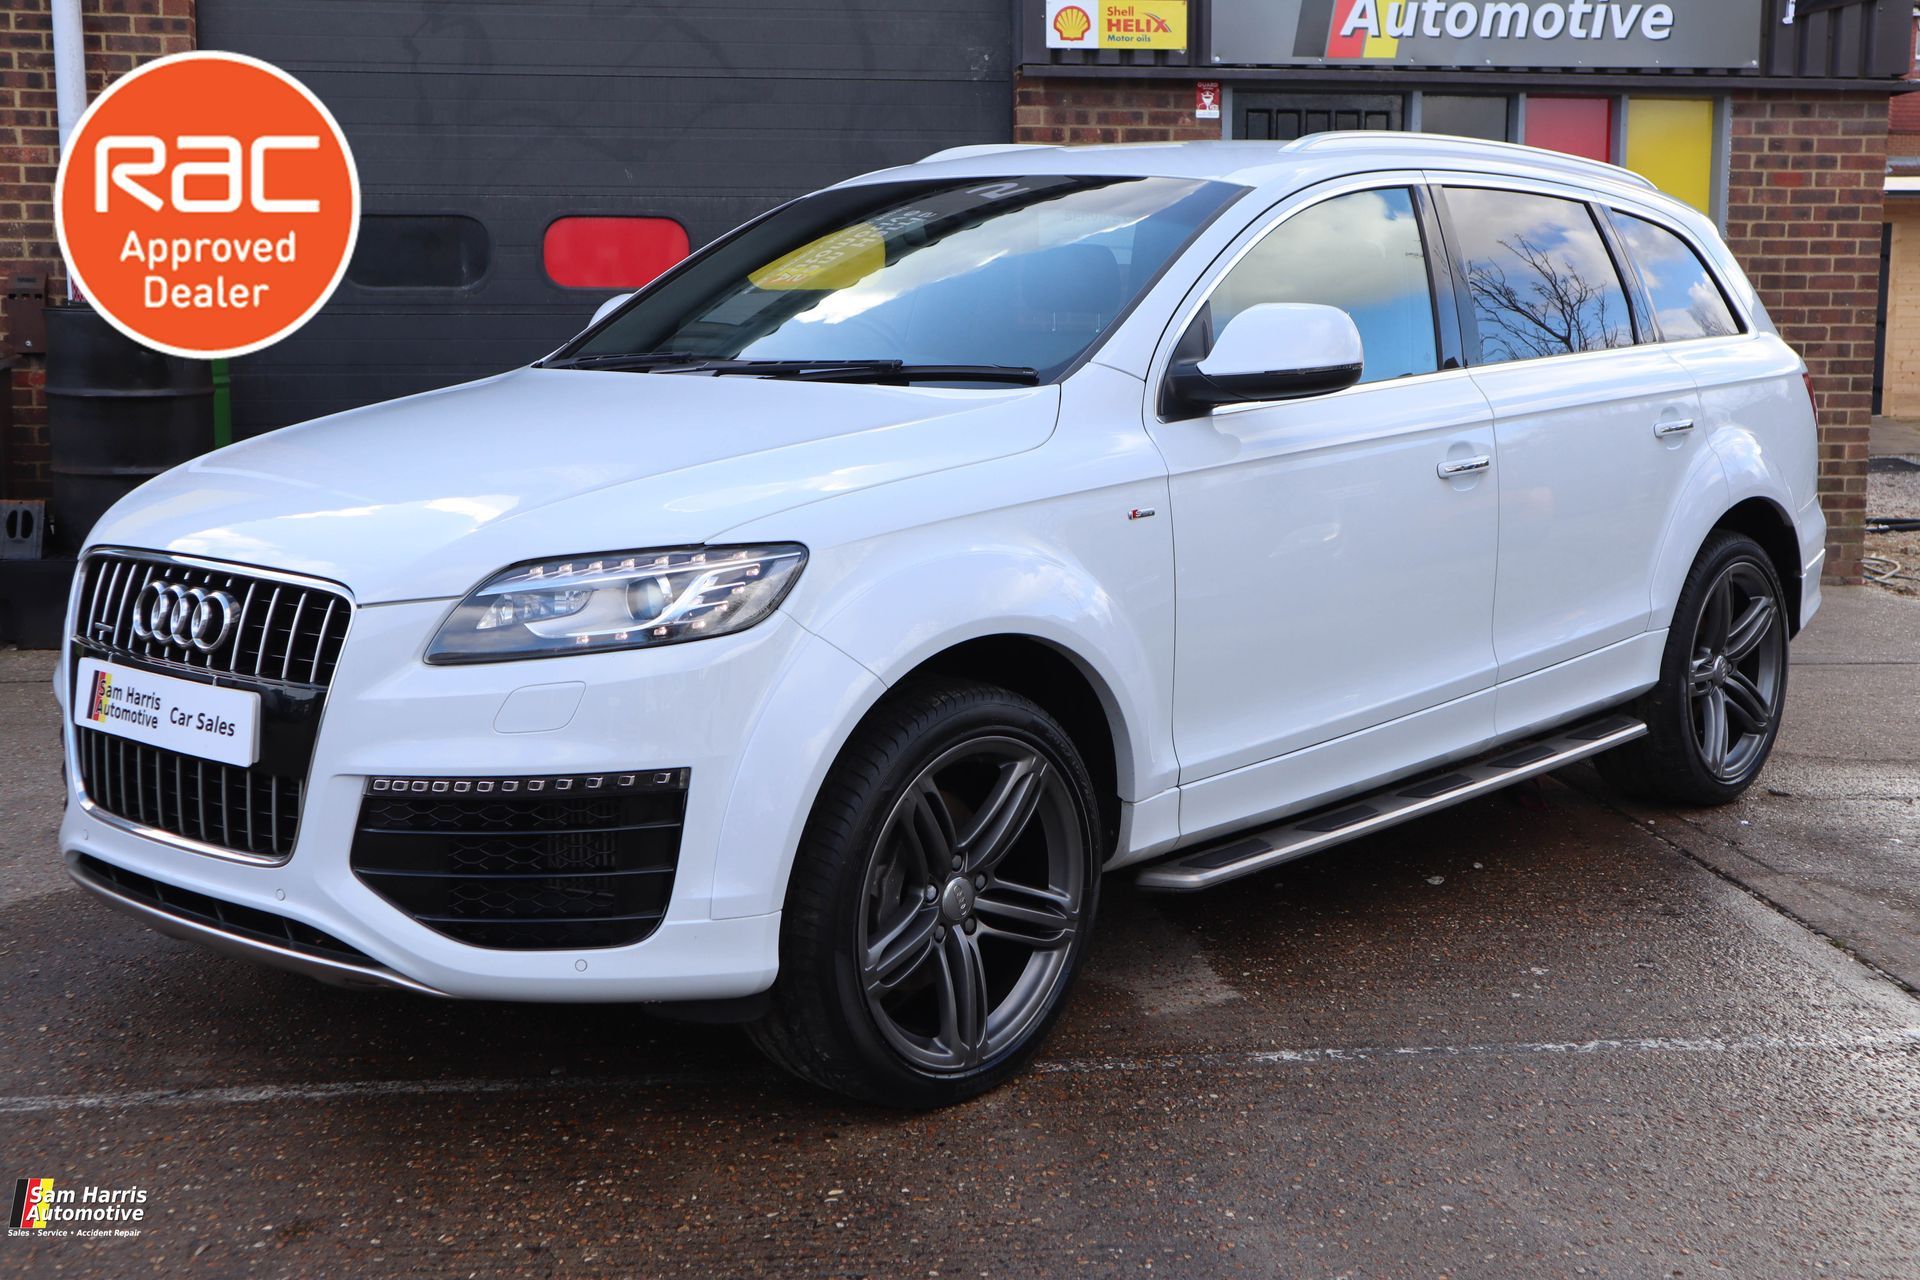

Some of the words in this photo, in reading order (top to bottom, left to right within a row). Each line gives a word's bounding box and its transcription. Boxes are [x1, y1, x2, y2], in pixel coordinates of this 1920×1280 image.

[1107, 6, 1134, 16] Shell
[1107, 16, 1171, 33] HELIX
[1340, 0, 1675, 40] Automotive
[1107, 34, 1134, 43] Motor
[1136, 34, 1151, 42] oils
[98, 679, 123, 701] Sam
[126, 686, 161, 711] Harris
[96, 701, 158, 729] Automotive
[170, 707, 193, 728] Car
[196, 713, 236, 737] Sales
